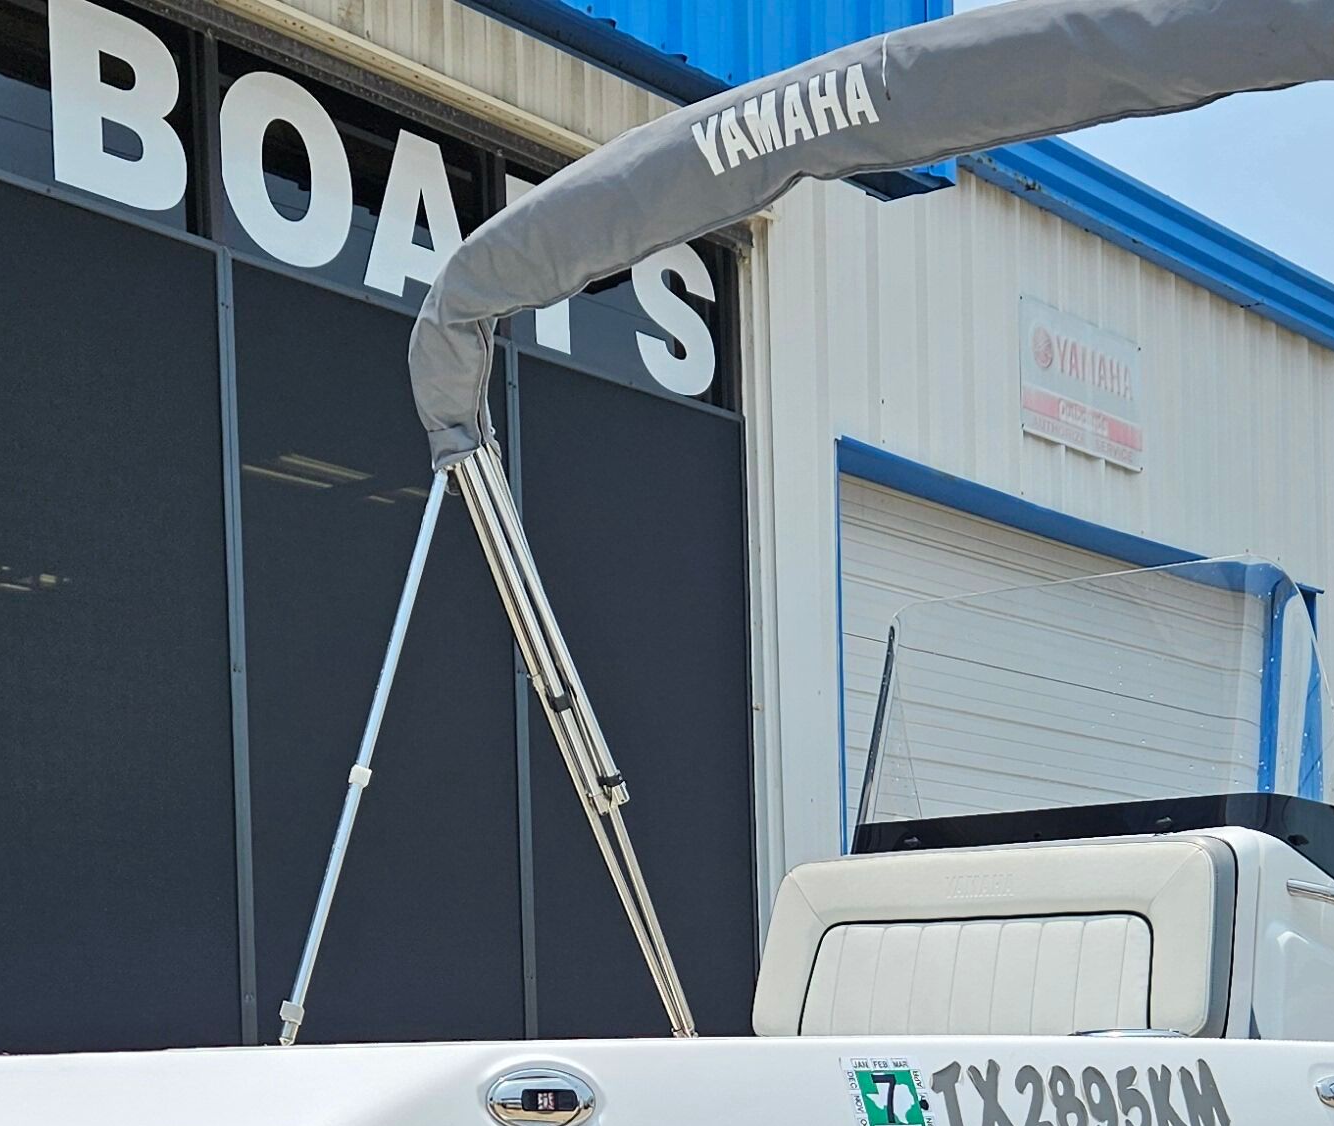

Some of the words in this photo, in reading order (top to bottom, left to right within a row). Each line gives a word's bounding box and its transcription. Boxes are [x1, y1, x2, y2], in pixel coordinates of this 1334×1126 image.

[691, 63, 880, 176] YAMAHA
[48, 0, 716, 396] BOAS
[1056, 334, 1134, 401] YAMAHA
[847, 1071, 858, 1089] DEC
[853, 1060, 869, 1069] JAN
[873, 1060, 888, 1069] FEB
[892, 1060, 908, 1068] MAR
[912, 1070, 924, 1089] APR
[854, 1095, 865, 1113] NOV
[871, 1073, 897, 1124] 7
